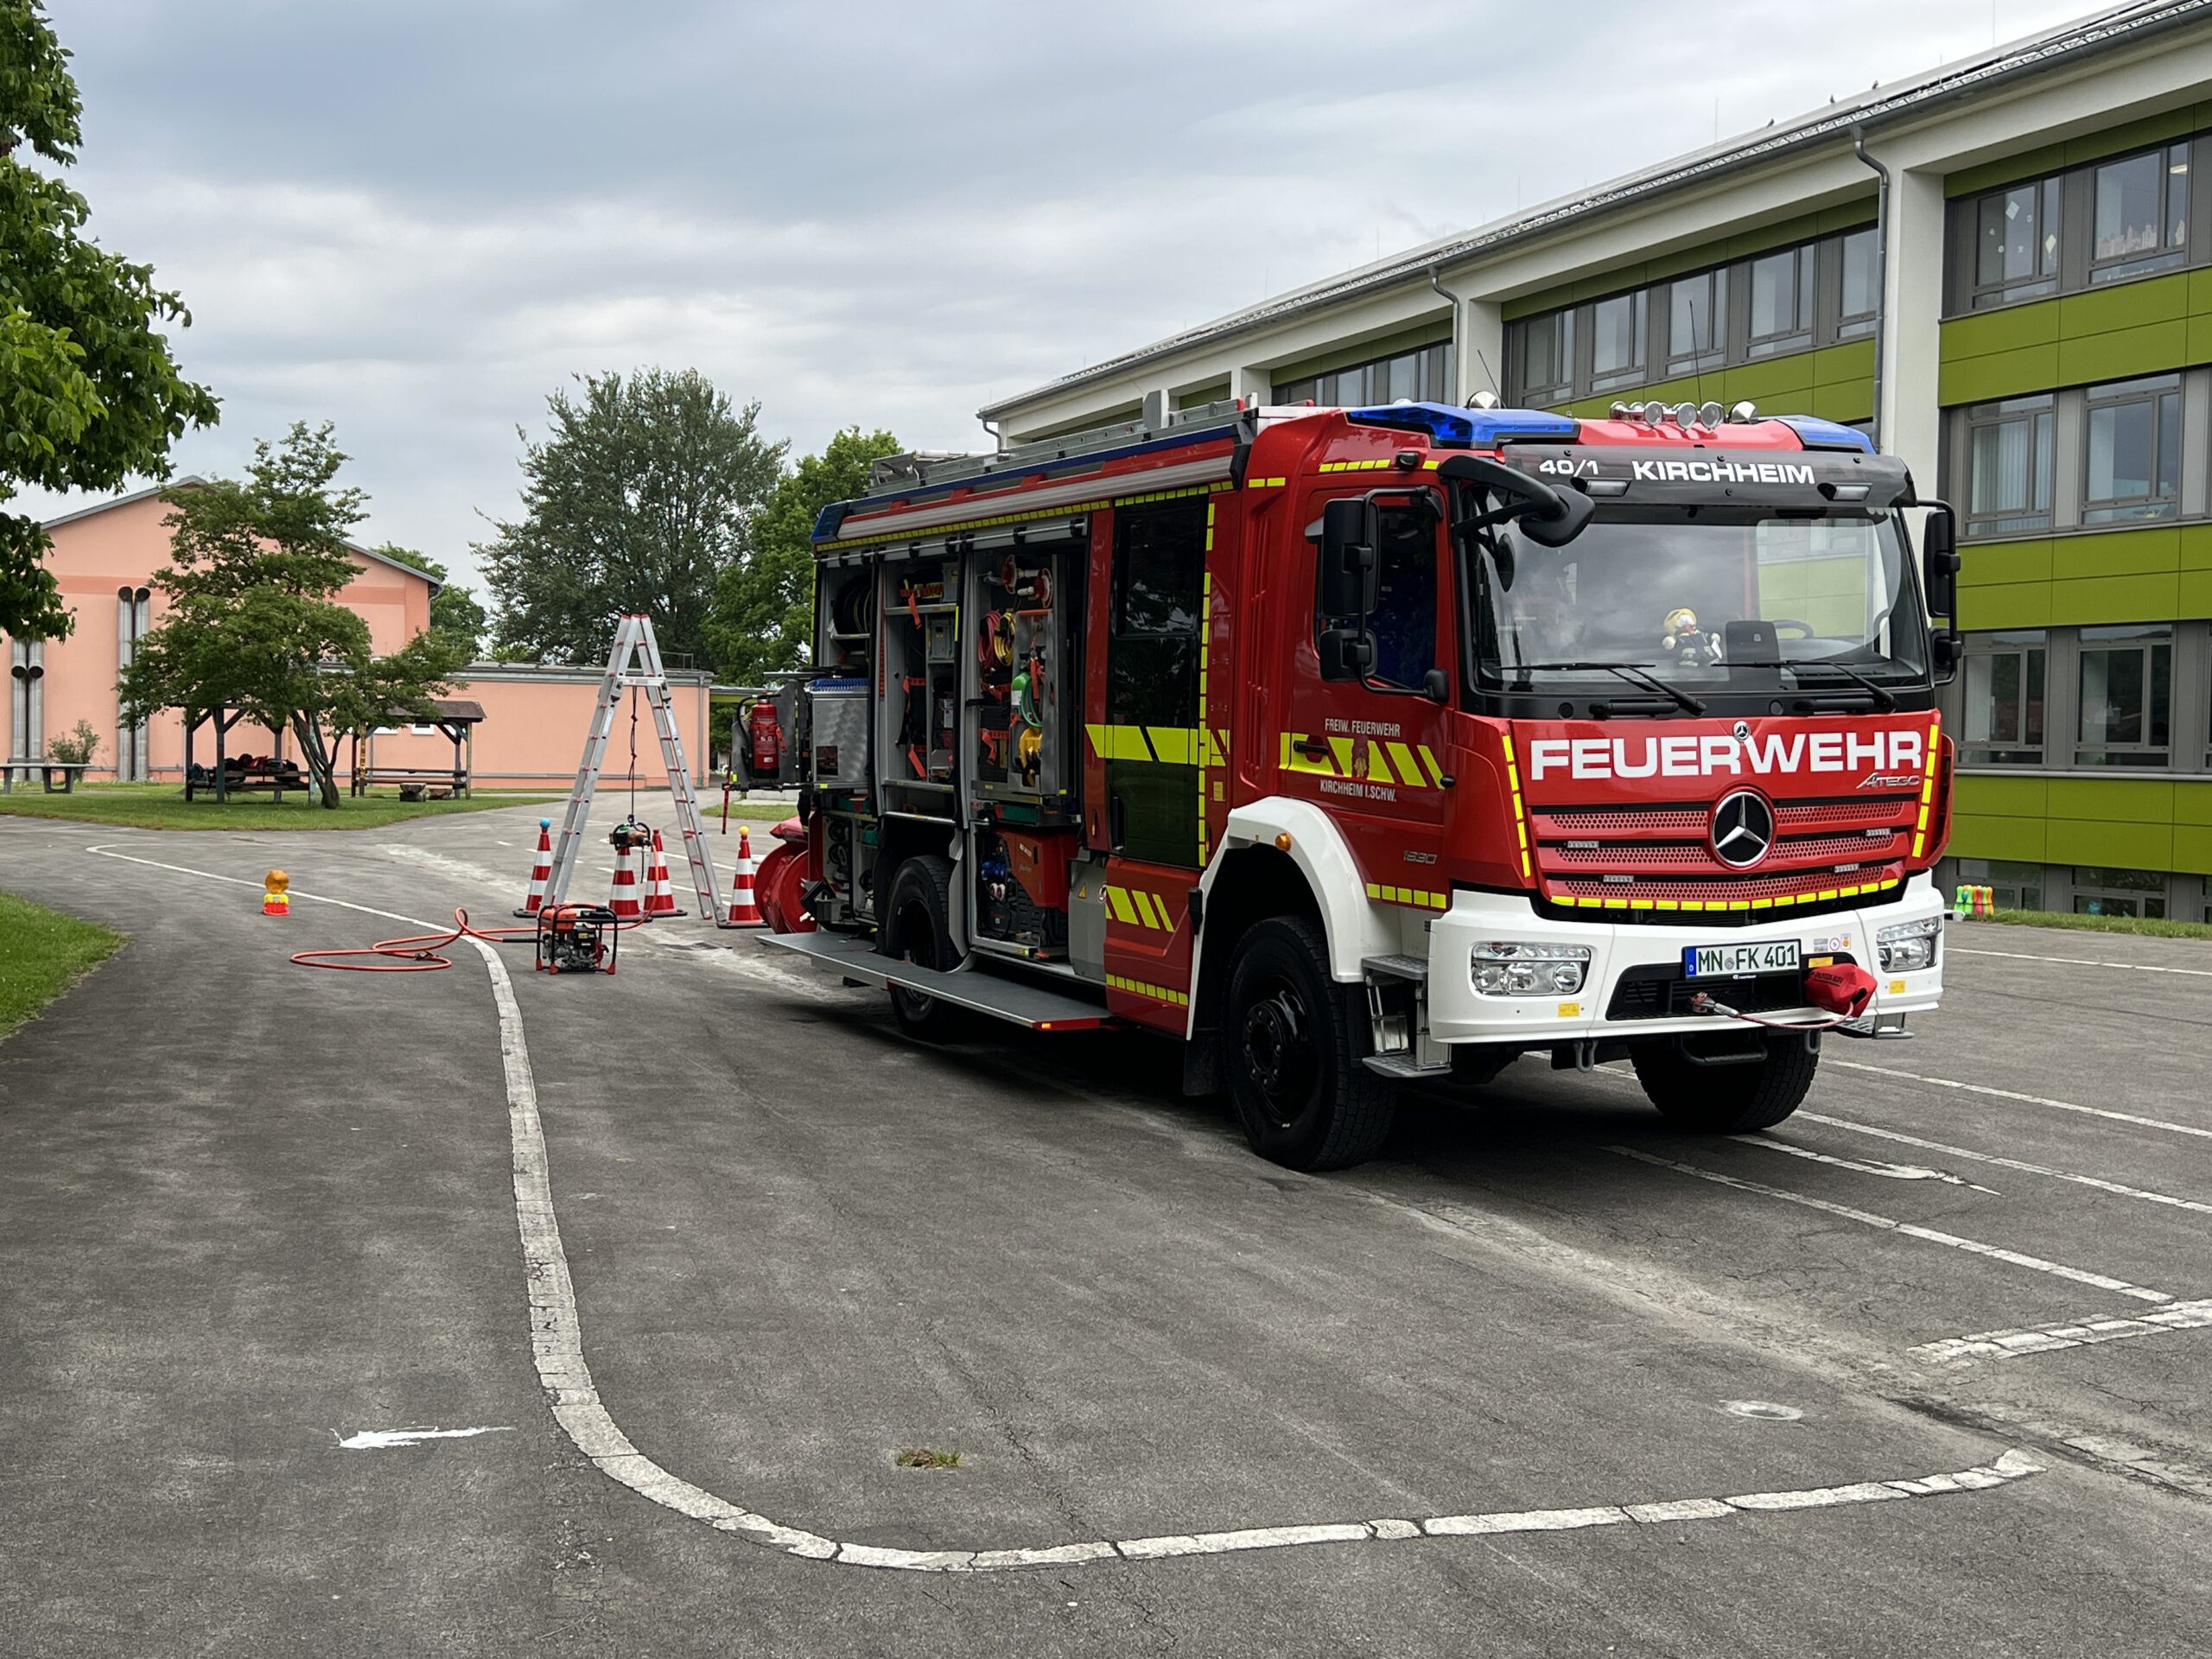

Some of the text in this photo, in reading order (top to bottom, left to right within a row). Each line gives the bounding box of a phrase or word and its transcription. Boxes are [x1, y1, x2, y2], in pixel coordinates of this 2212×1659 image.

[1538, 459, 1815, 485] 40/1 KIRCHHEIM
[1325, 718, 1401, 737] FREIW. FEUERWEHR
[1530, 730, 1922, 781] FEUERWEHR
[1319, 779, 1363, 797] KIRCHHEIM
[1698, 949, 1724, 973] MN
[1735, 947, 1759, 970] FK
[1764, 944, 1798, 968] 401
